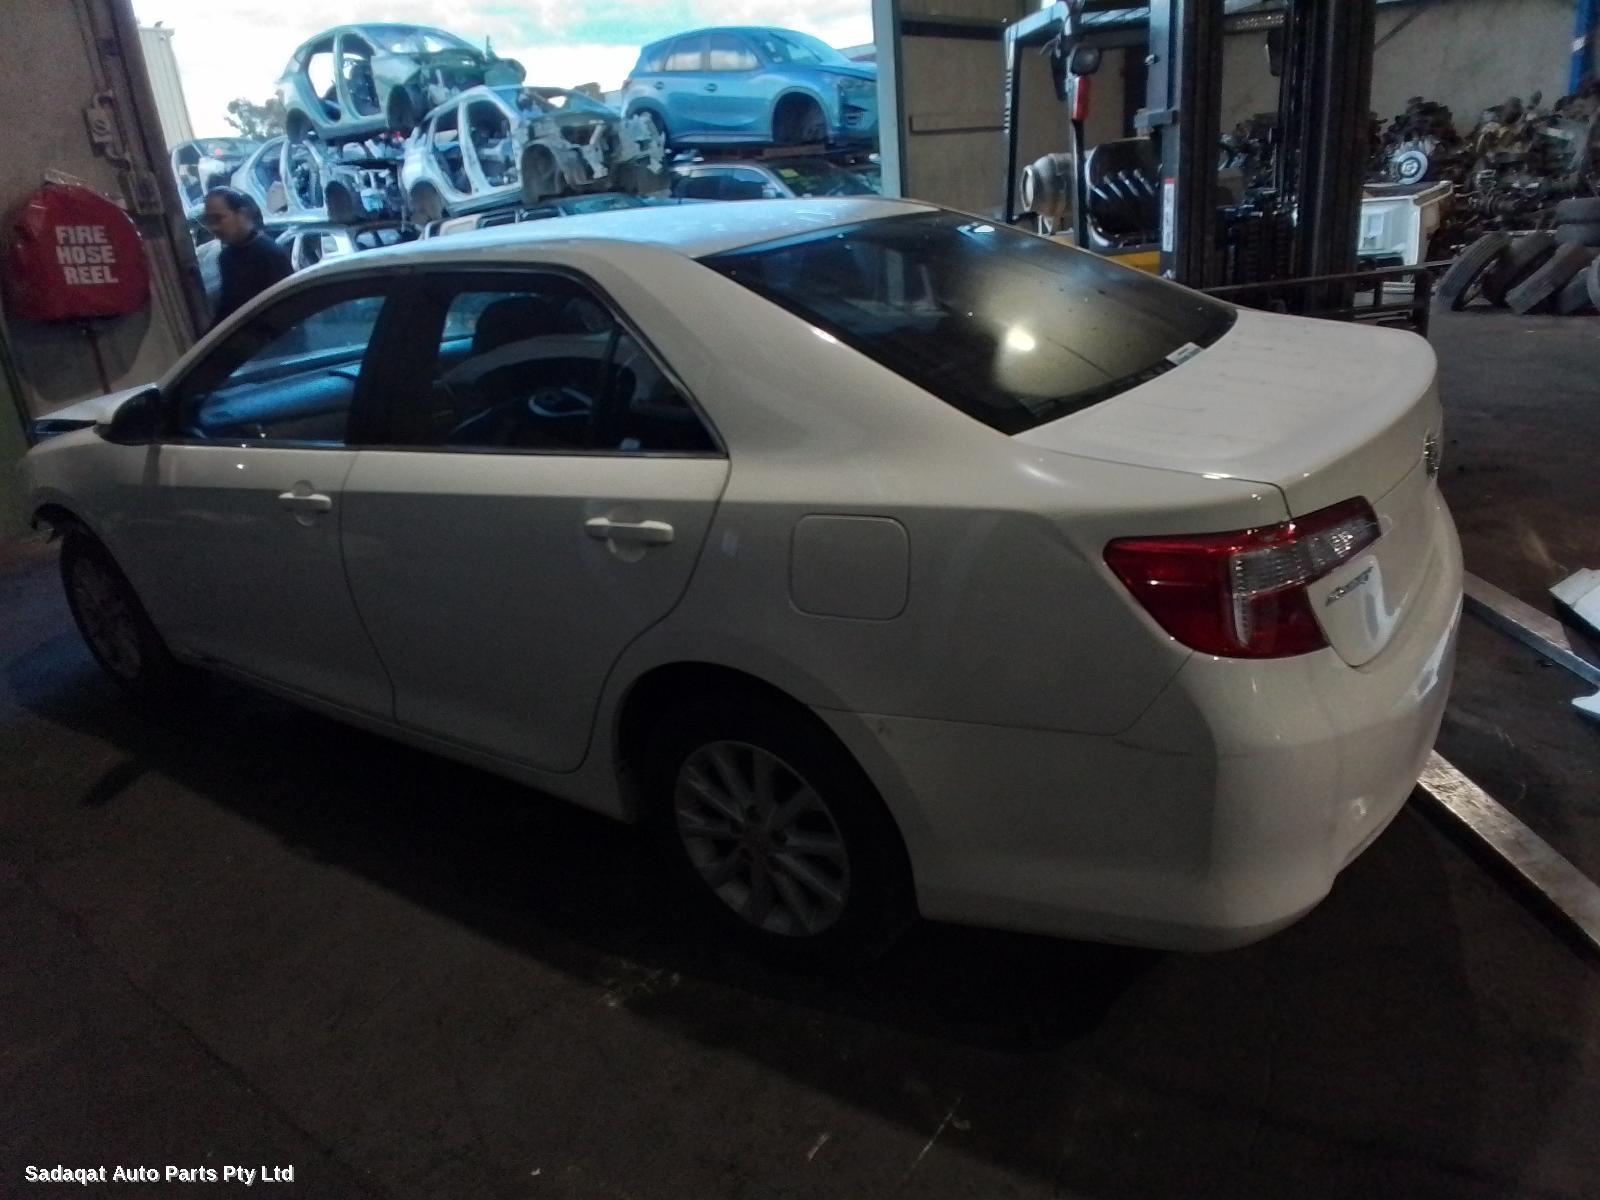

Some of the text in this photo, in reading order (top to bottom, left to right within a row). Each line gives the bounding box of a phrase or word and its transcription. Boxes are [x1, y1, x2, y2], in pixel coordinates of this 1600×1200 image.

[55, 225, 108, 244] FIRE
[55, 245, 116, 264] HOSE
[63, 265, 119, 285] REEL
